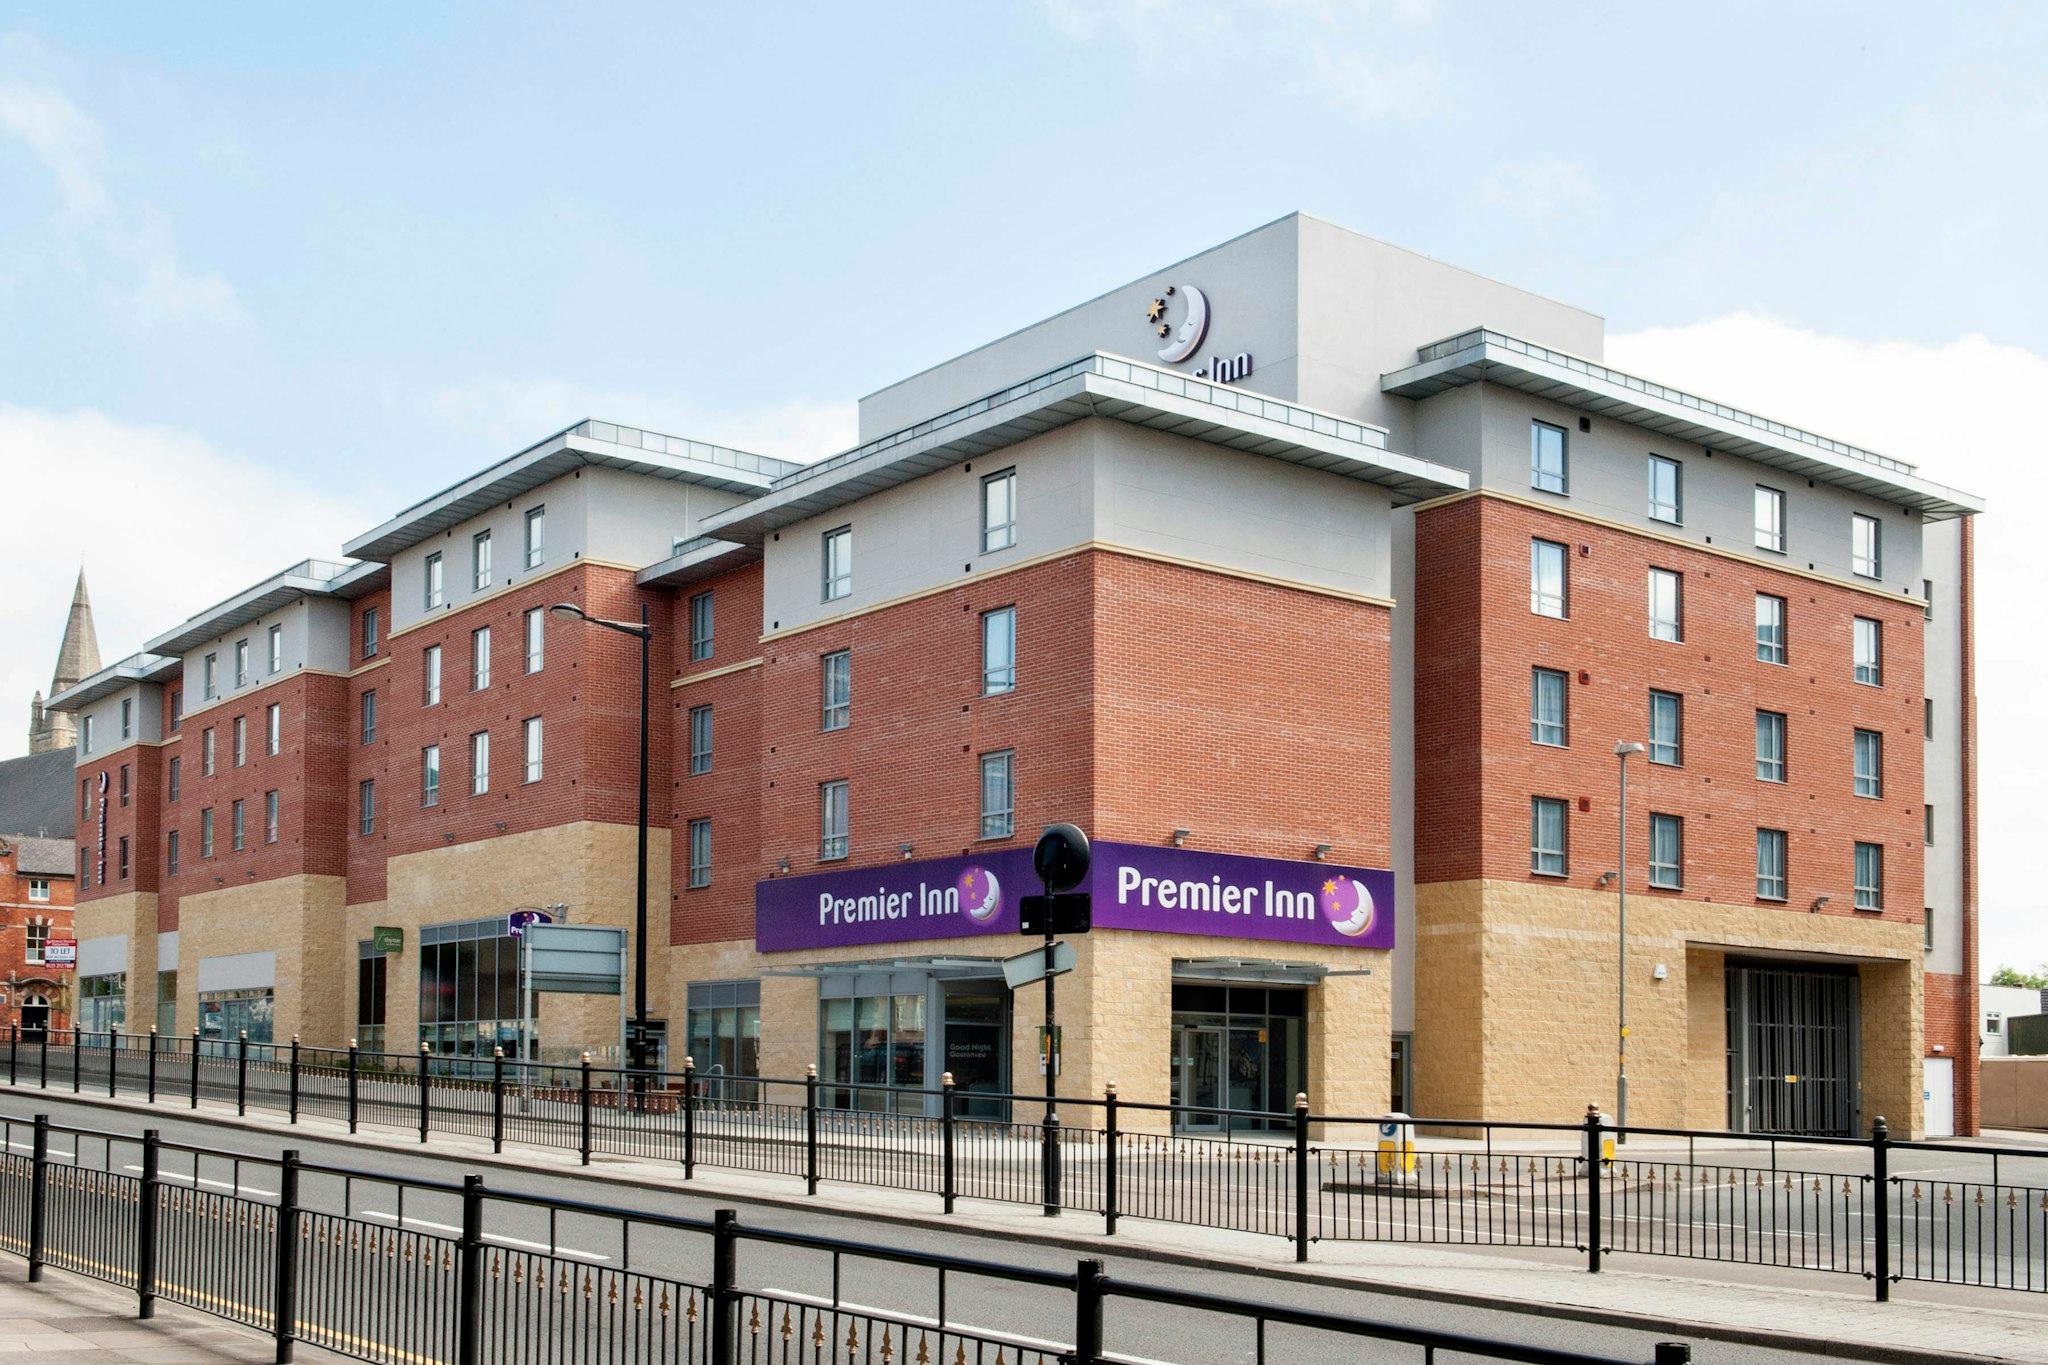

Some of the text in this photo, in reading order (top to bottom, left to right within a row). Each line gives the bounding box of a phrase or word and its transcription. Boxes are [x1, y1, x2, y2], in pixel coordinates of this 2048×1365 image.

[1209, 353, 1252, 384] Inn
[98, 798, 106, 885] Premier Inn
[819, 882, 959, 926] Premier Inn
[1118, 866, 1315, 920] Premier Inn
[50, 947, 70, 955] TO LET
[949, 1043, 992, 1052] Good Night
